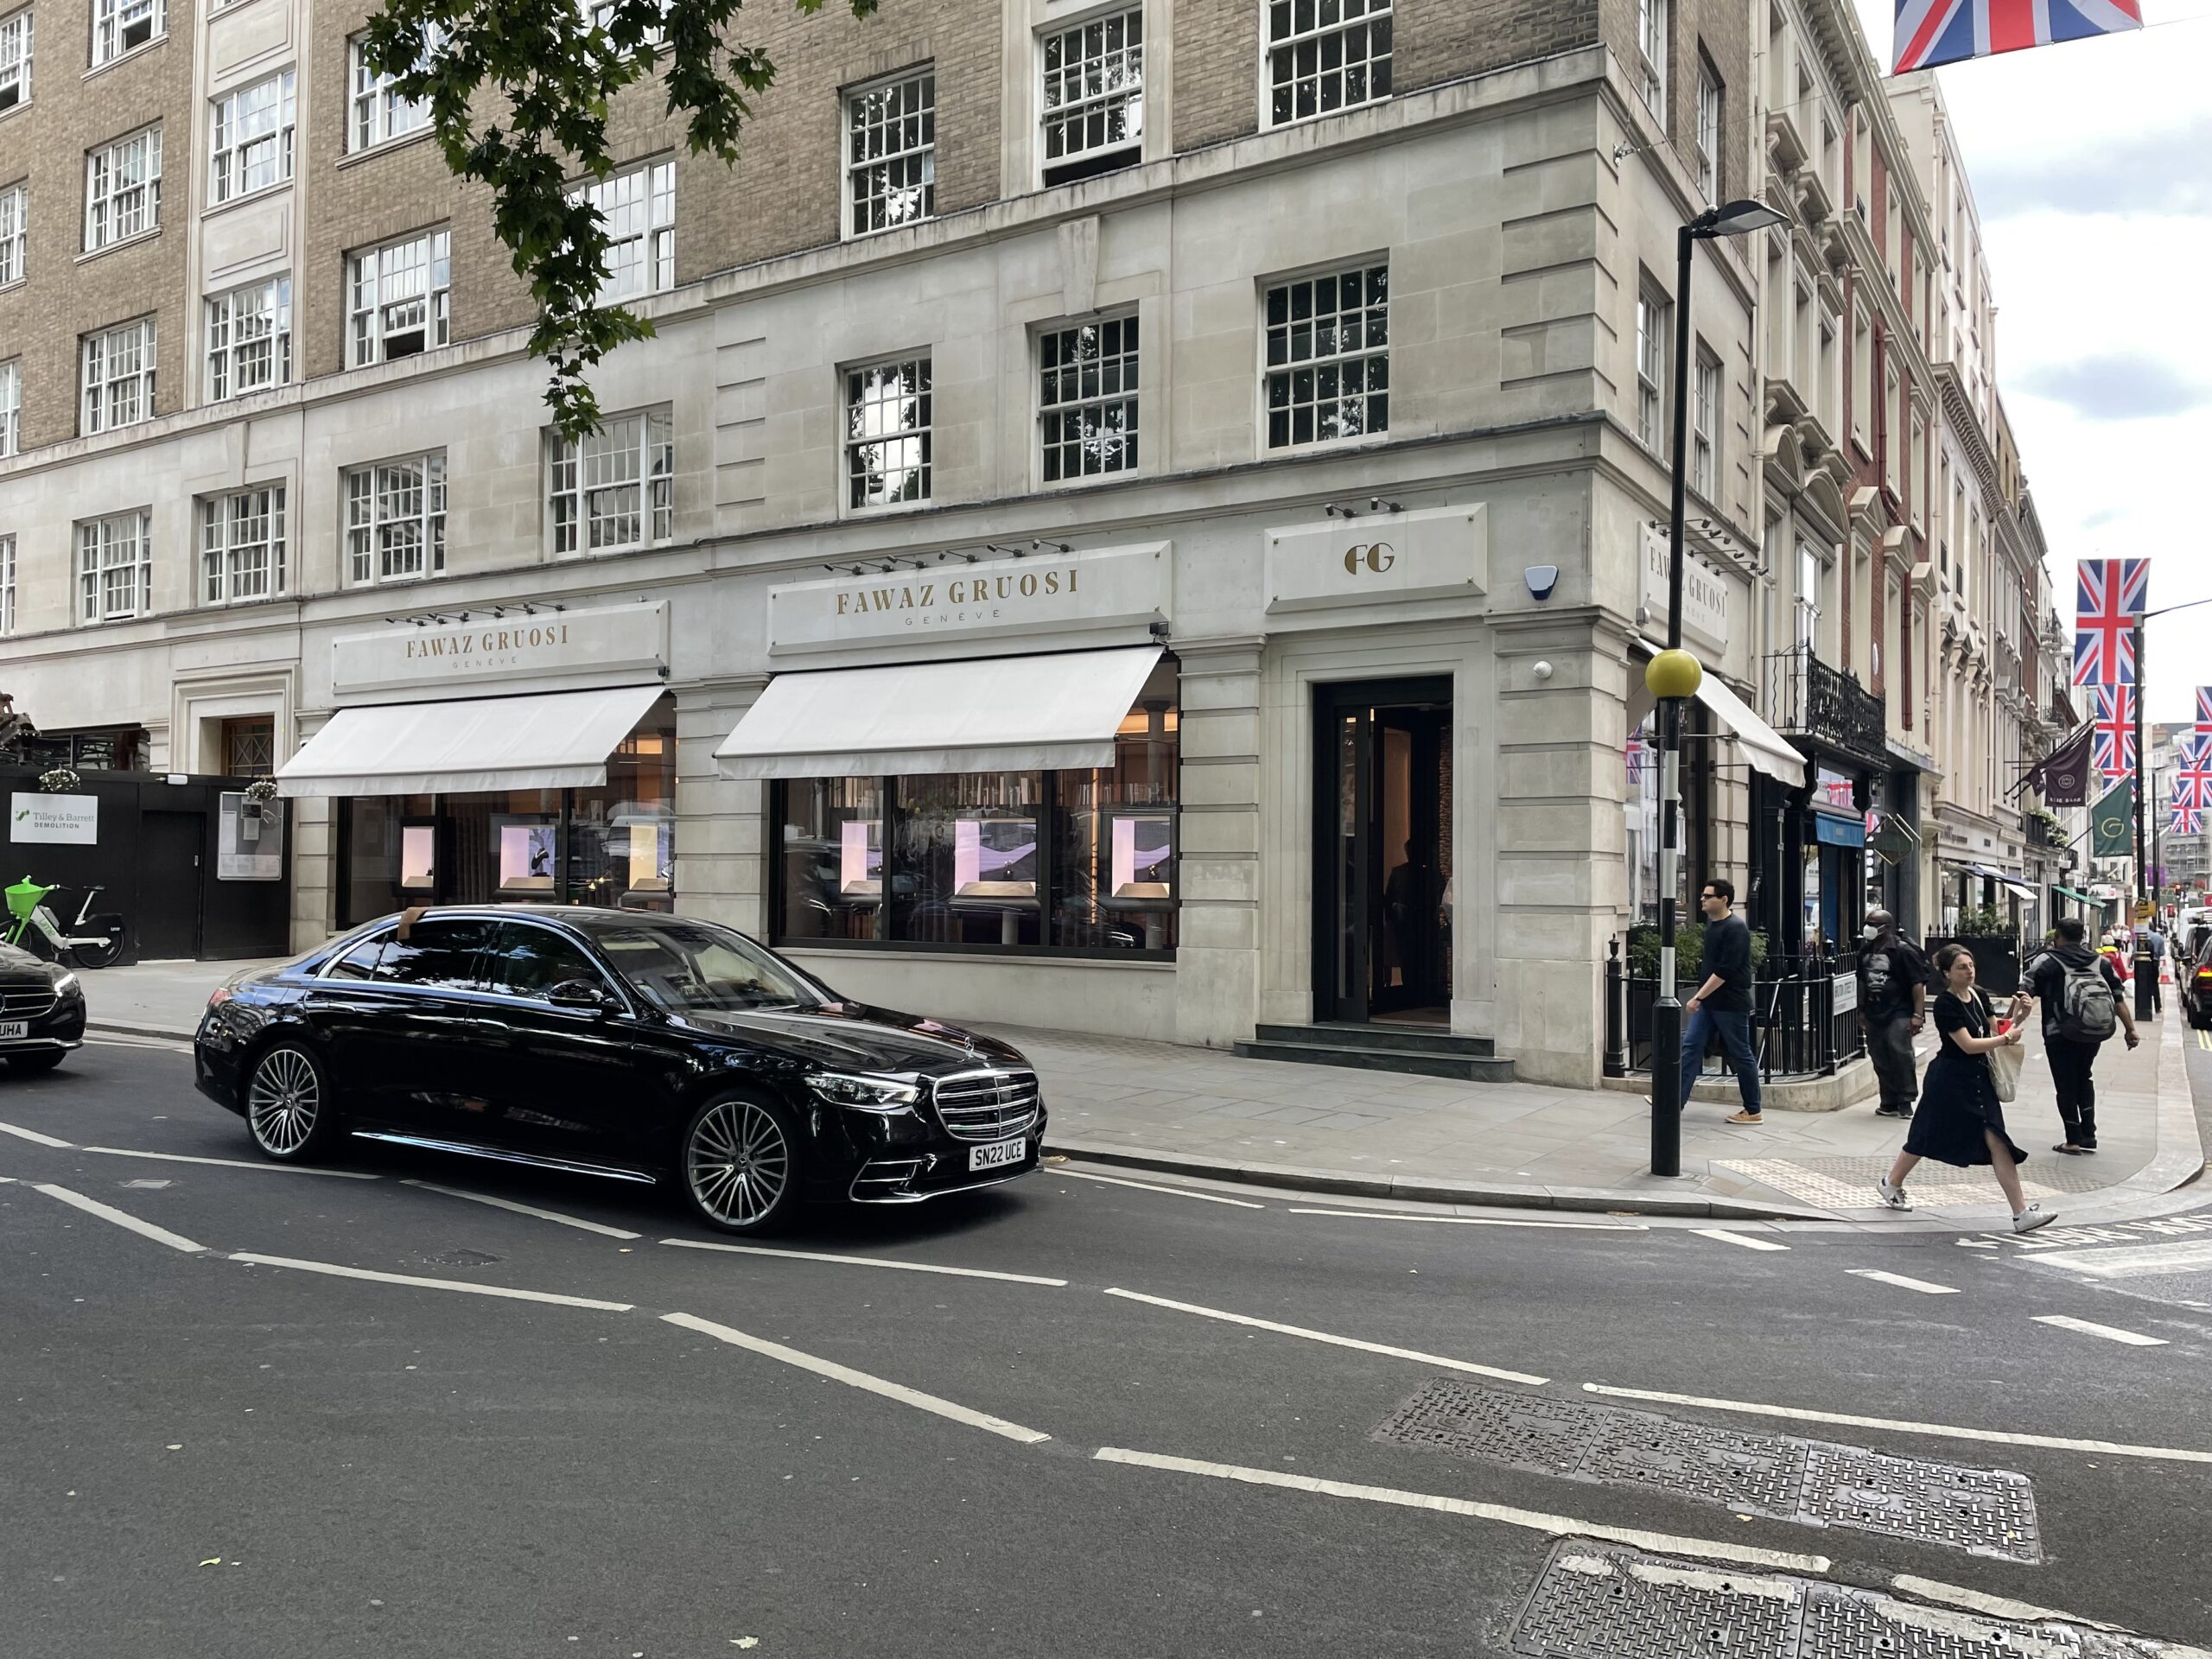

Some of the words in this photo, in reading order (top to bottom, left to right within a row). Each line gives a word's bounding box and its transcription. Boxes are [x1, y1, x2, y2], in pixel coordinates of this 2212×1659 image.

[836, 584, 935, 615] FAWAZ
[949, 569, 1079, 604] GRUOSI
[1689, 573, 1725, 618] GRUOSI
[406, 635, 473, 659] FAWAZ
[482, 625, 569, 652] GRUOSI
[33, 812, 57, 822] Tilley
[66, 813, 94, 823] Barrett
[975, 1146, 1003, 1167] SN22
[1005, 1141, 1022, 1161] UCE
